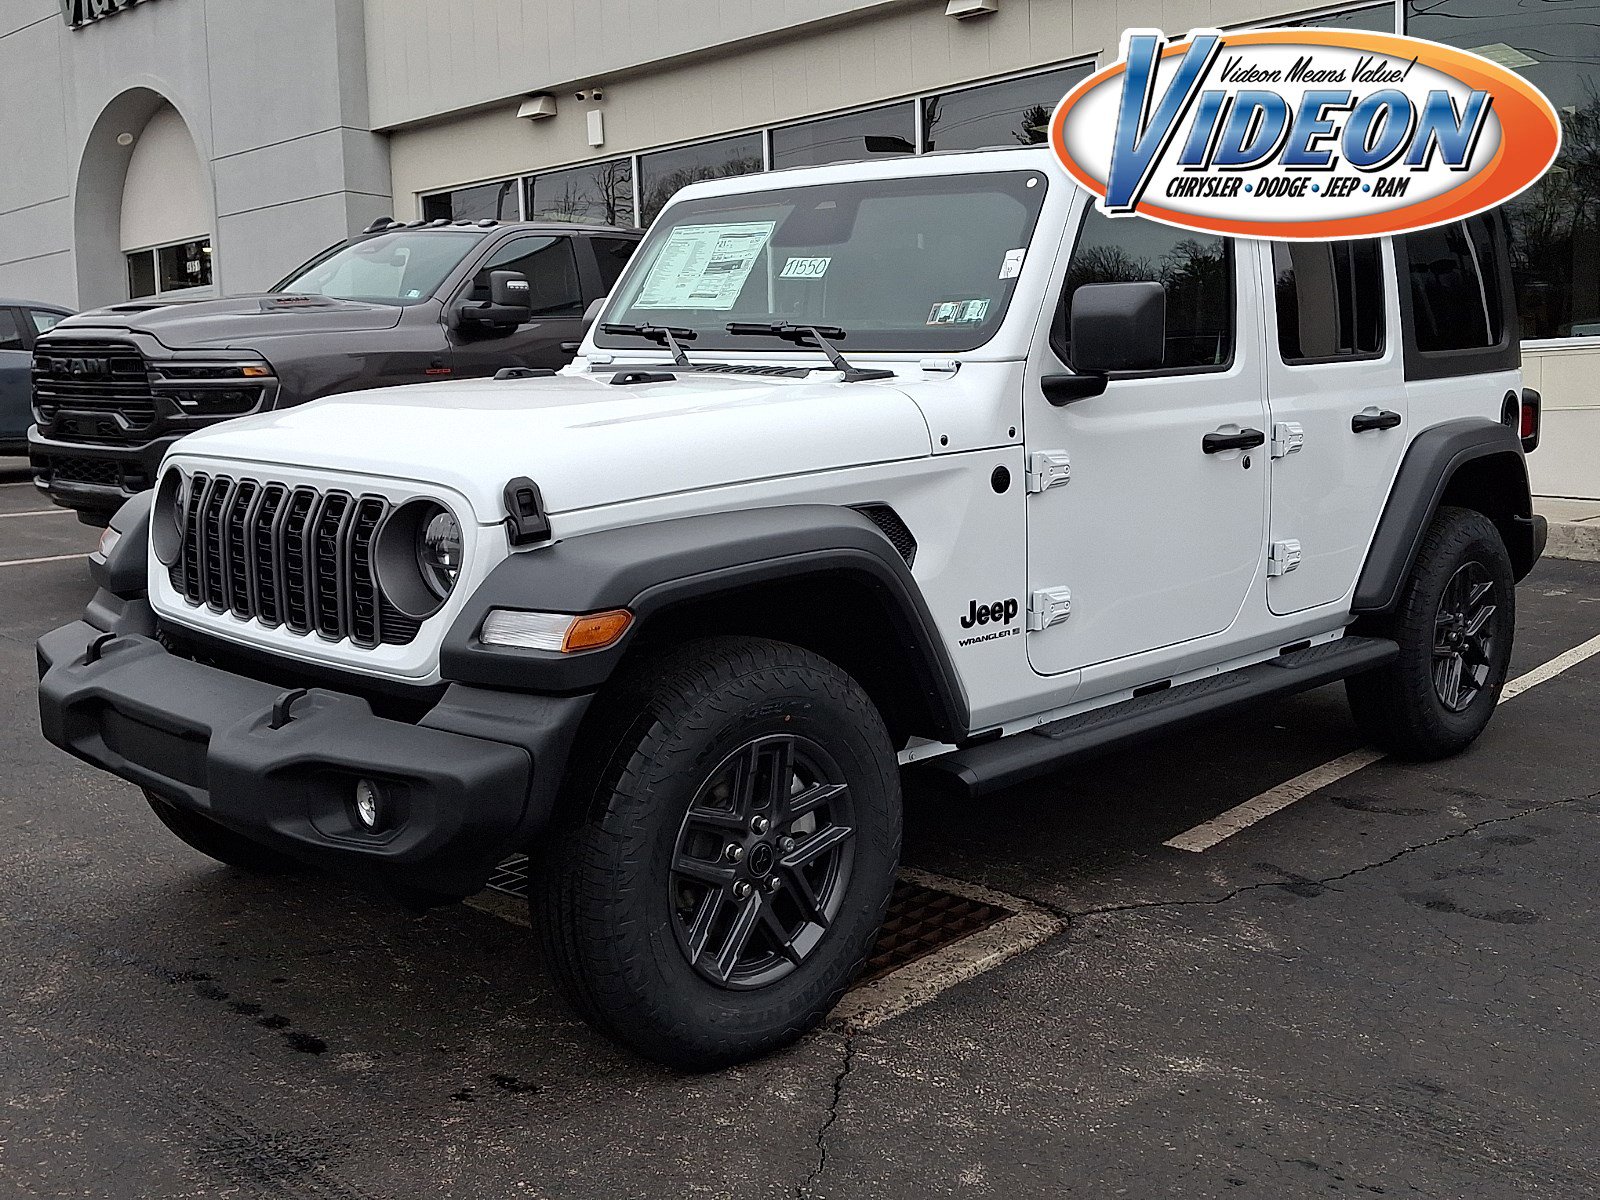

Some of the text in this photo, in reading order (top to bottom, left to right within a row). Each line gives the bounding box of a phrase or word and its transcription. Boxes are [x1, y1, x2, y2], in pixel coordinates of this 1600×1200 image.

[786, 259, 826, 275] 11550
[51, 358, 108, 374] RAM
[960, 598, 1018, 629] Jeep
[959, 630, 1010, 647] WRANGLER
